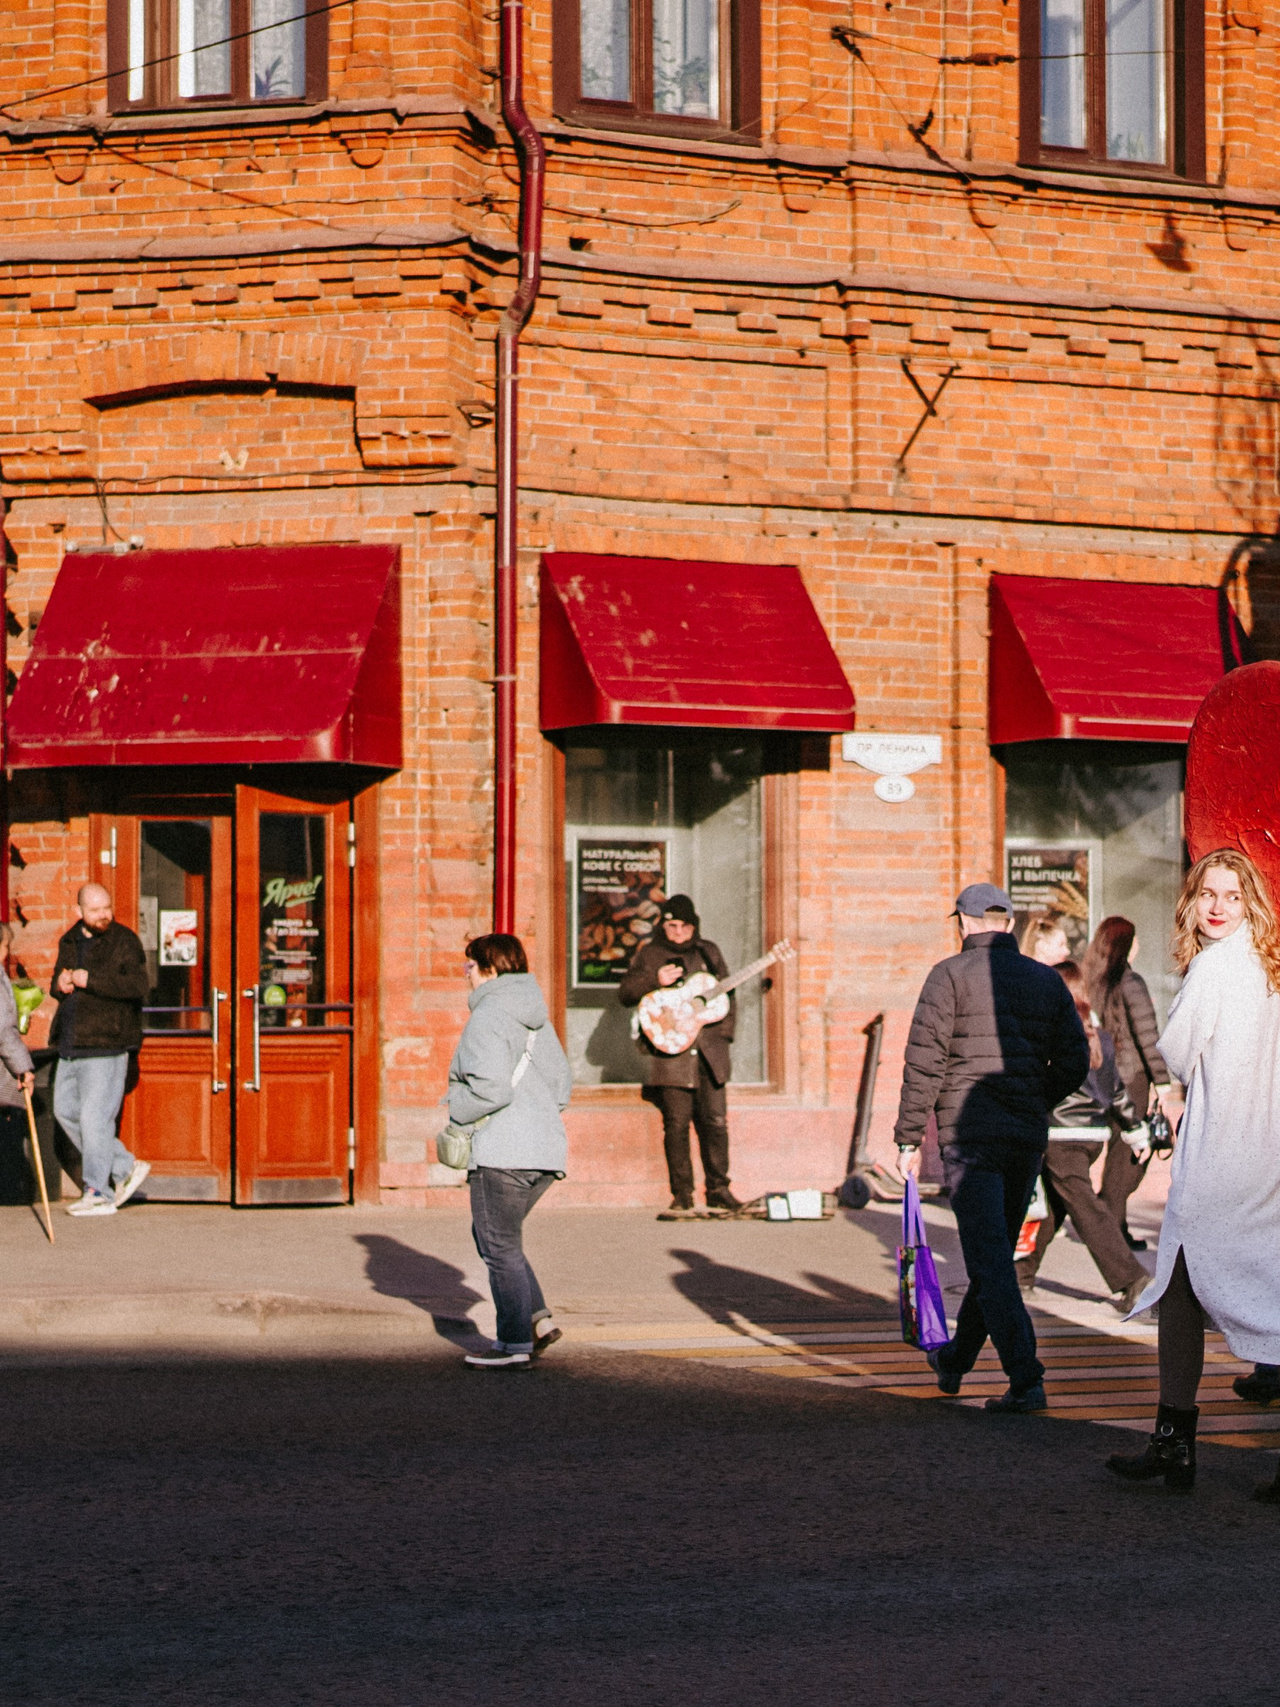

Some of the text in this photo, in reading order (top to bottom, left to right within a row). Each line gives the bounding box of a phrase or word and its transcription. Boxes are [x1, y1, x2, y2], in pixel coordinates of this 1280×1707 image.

[879, 743, 926, 753] ЛЕНИНА
[582, 848, 661, 860] НАТУРАЛЬНЫЙ
[582, 861, 612, 871] КОФЕ
[623, 860, 661, 872] СОБОЙ
[1011, 855, 1041, 868] ХЛЕБ
[1011, 870, 1081, 882] И ВЫПЕЧКА
[263, 875, 322, 907] Ярче!
